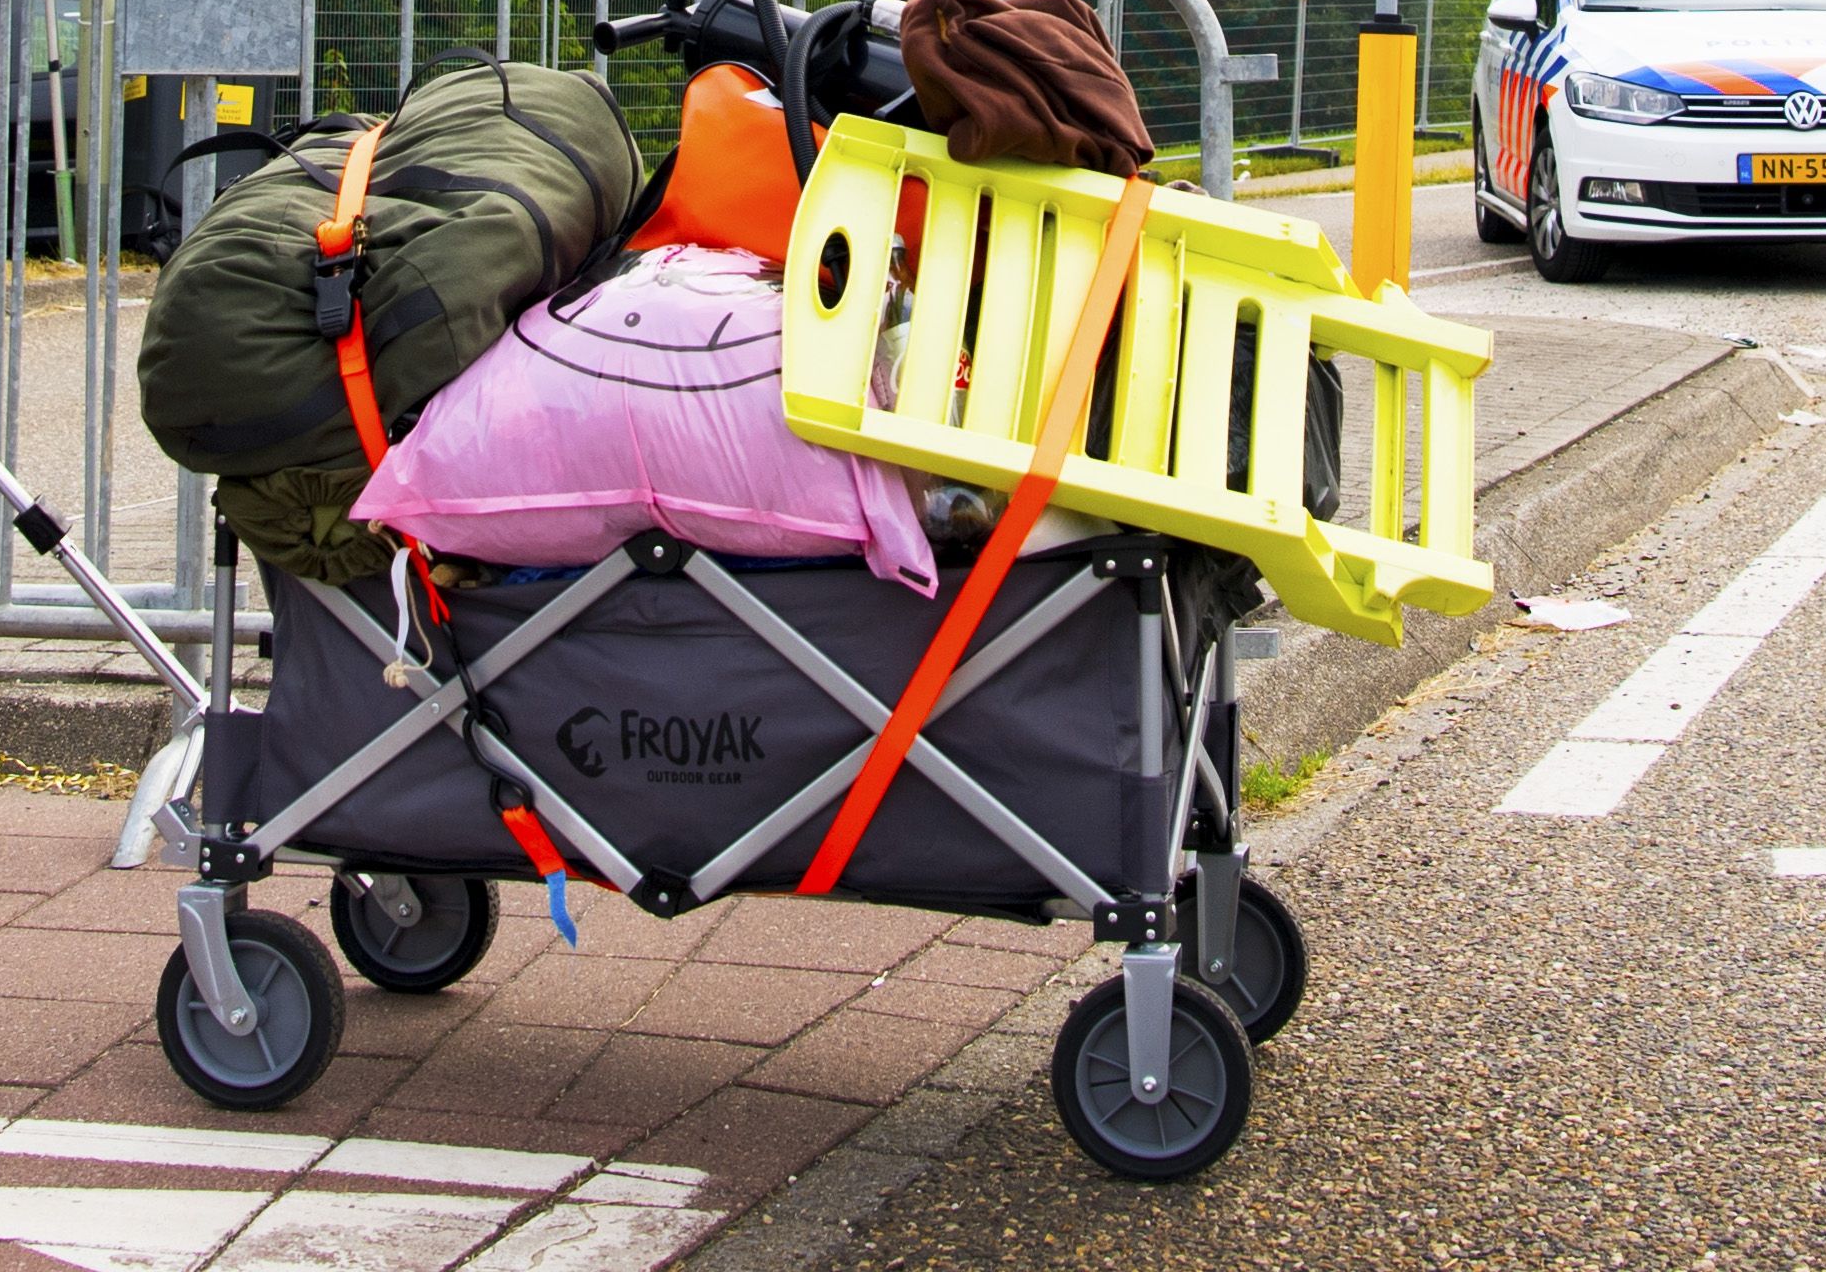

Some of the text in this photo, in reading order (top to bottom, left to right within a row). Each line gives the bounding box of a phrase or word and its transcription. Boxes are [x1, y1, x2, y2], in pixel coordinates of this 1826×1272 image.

[619, 708, 766, 767] FROYAK
[646, 769, 742, 785] OUTDOOR GEAR
